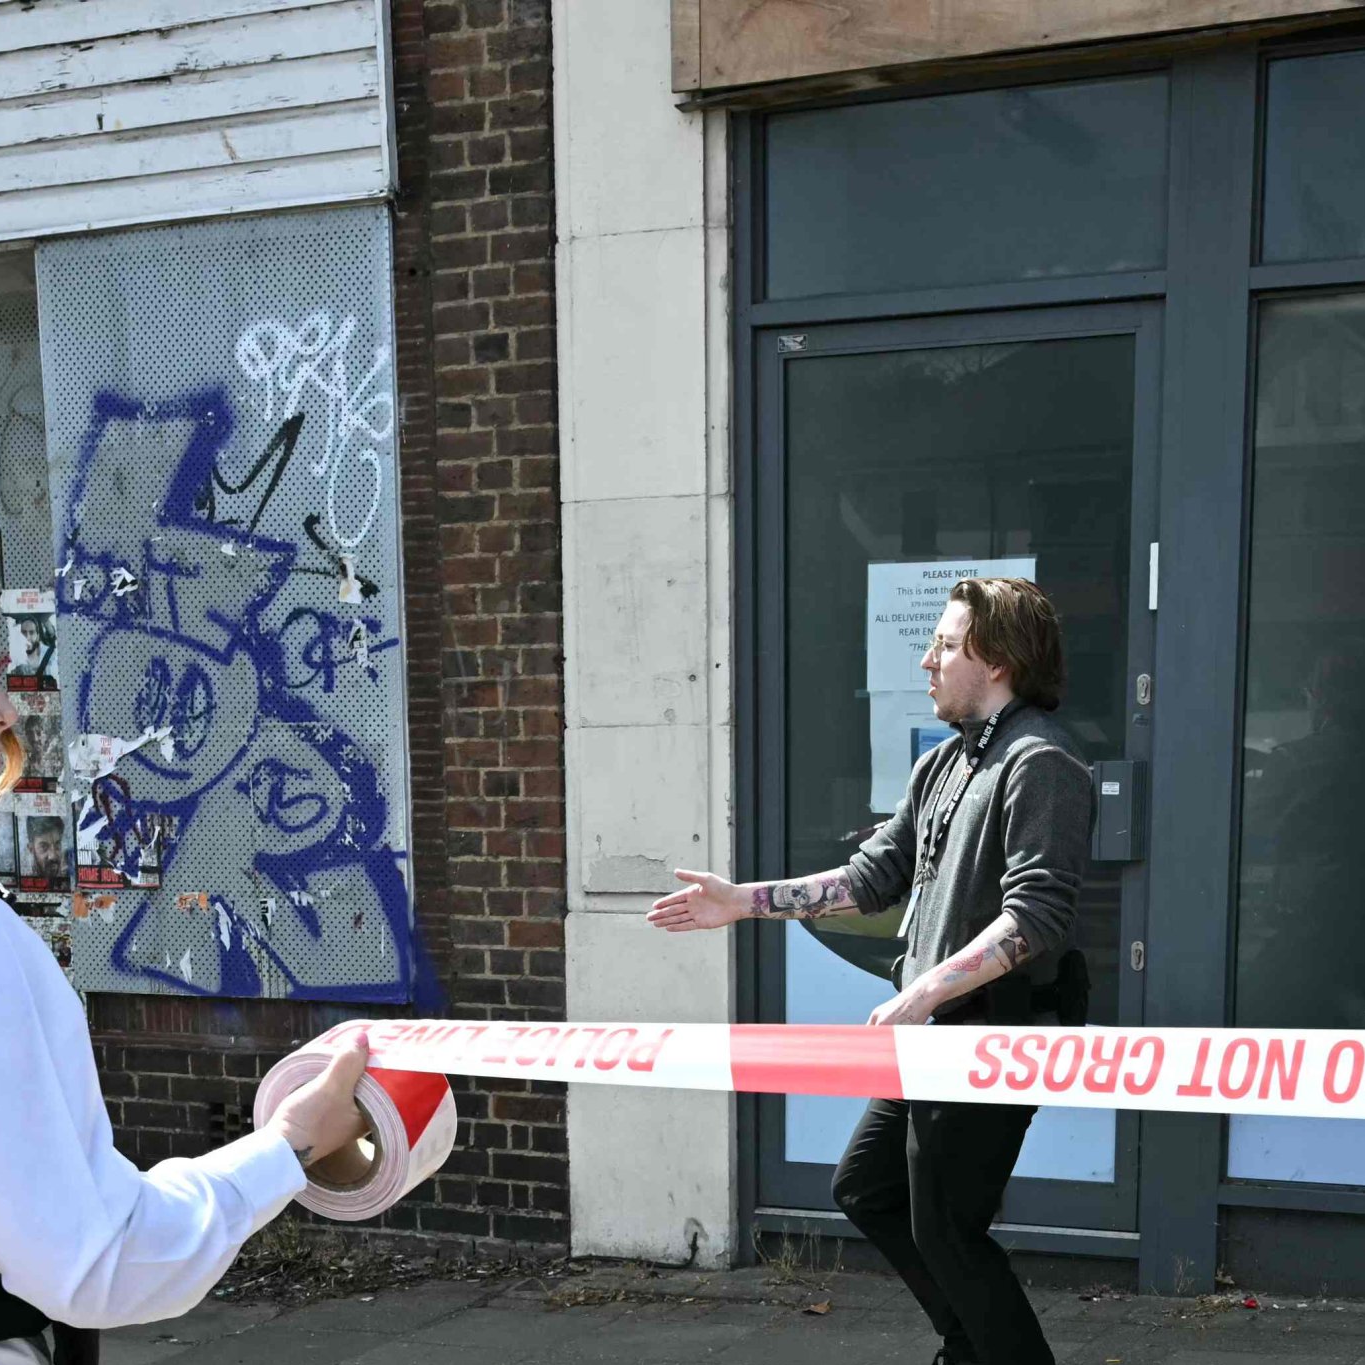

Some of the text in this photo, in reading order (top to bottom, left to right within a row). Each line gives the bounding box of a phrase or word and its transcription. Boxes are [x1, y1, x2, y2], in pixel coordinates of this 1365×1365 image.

[923, 569, 979, 579] PLEASE NOTE
[897, 587, 914, 596] This
[915, 587, 922, 595] is
[924, 587, 938, 595] not
[875, 614, 889, 623] ALL
[891, 612, 937, 622] DELIVERIES
[898, 628, 920, 636] REAR
[977, 725, 995, 749] POLICE
[481, 1026, 675, 1073] POLICE
[968, 1033, 1165, 1096] CROSS
[1176, 1037, 1306, 1101] NOT
